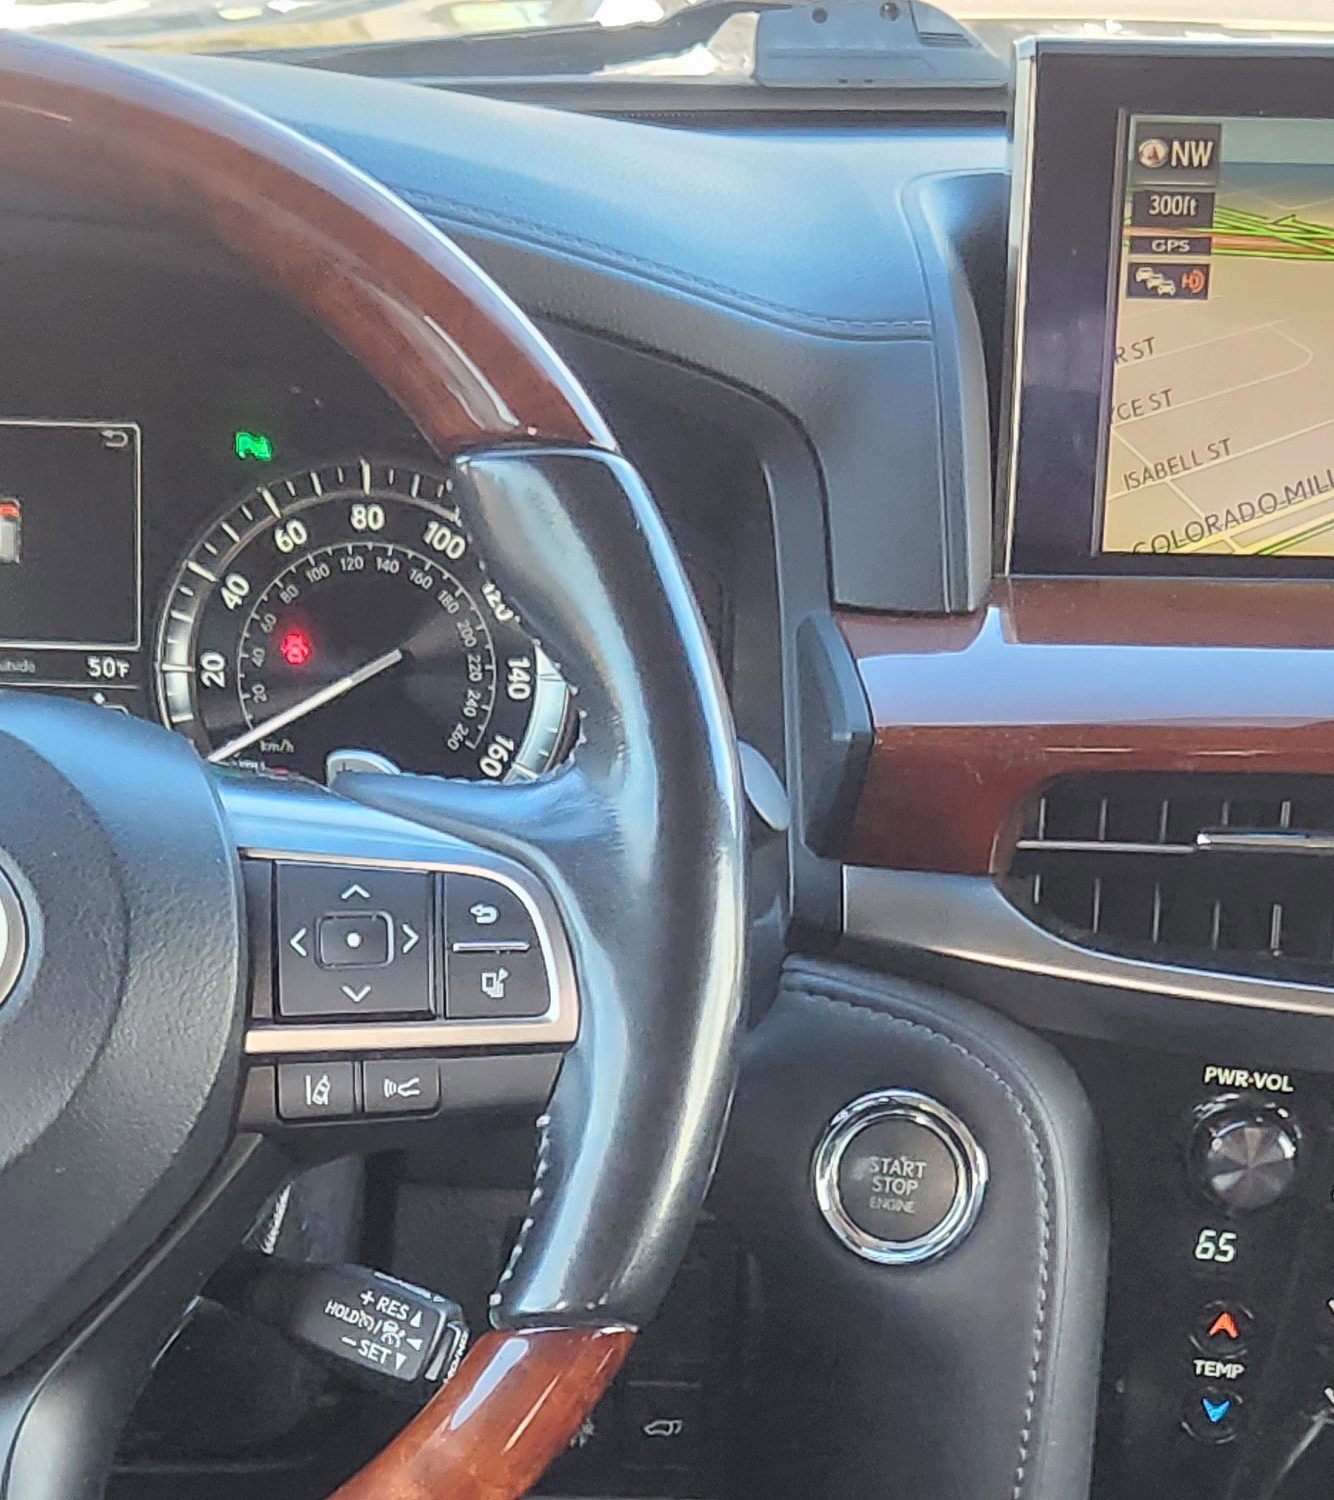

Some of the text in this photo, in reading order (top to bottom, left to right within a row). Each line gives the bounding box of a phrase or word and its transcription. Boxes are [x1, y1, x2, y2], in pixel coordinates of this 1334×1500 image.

[1170, 140, 1214, 168] NW
[1148, 195, 1197, 216] 300ft
[1151, 239, 1191, 252] GPS
[1132, 337, 1155, 360] ST
[1149, 389, 1172, 411] ST
[1123, 438, 1231, 491] ISABELL ST
[350, 504, 385, 531] 80
[1132, 493, 1278, 555] COLORADO
[275, 519, 307, 553] 60
[423, 521, 465, 560] 100
[306, 563, 330, 584] 100
[340, 556, 365, 572] 120
[376, 556, 400, 574] 140
[220, 573, 250, 610] 40
[408, 569, 433, 590] 160
[279, 584, 299, 604] 80
[437, 590, 460, 614] 180
[260, 613, 277, 634] 60
[457, 620, 477, 647] 200
[200, 651, 226, 688] 20
[468, 653, 482, 682] 220
[507, 657, 531, 700] 140
[252, 684, 267, 703] 20
[463, 689, 481, 718] 240
[259, 739, 294, 753] km/h
[447, 723, 469, 751] 260
[479, 734, 514, 777] 160
[869, 1156, 927, 1179] START
[871, 1178, 918, 1196] STOP
[869, 1197, 916, 1213] ENGINE
[1195, 1229, 1237, 1263] 65
[324, 1300, 361, 1328] HOLD
[376, 1296, 410, 1321] RES
[358, 1340, 392, 1364] SET
[1193, 1360, 1245, 1379] TEMP
